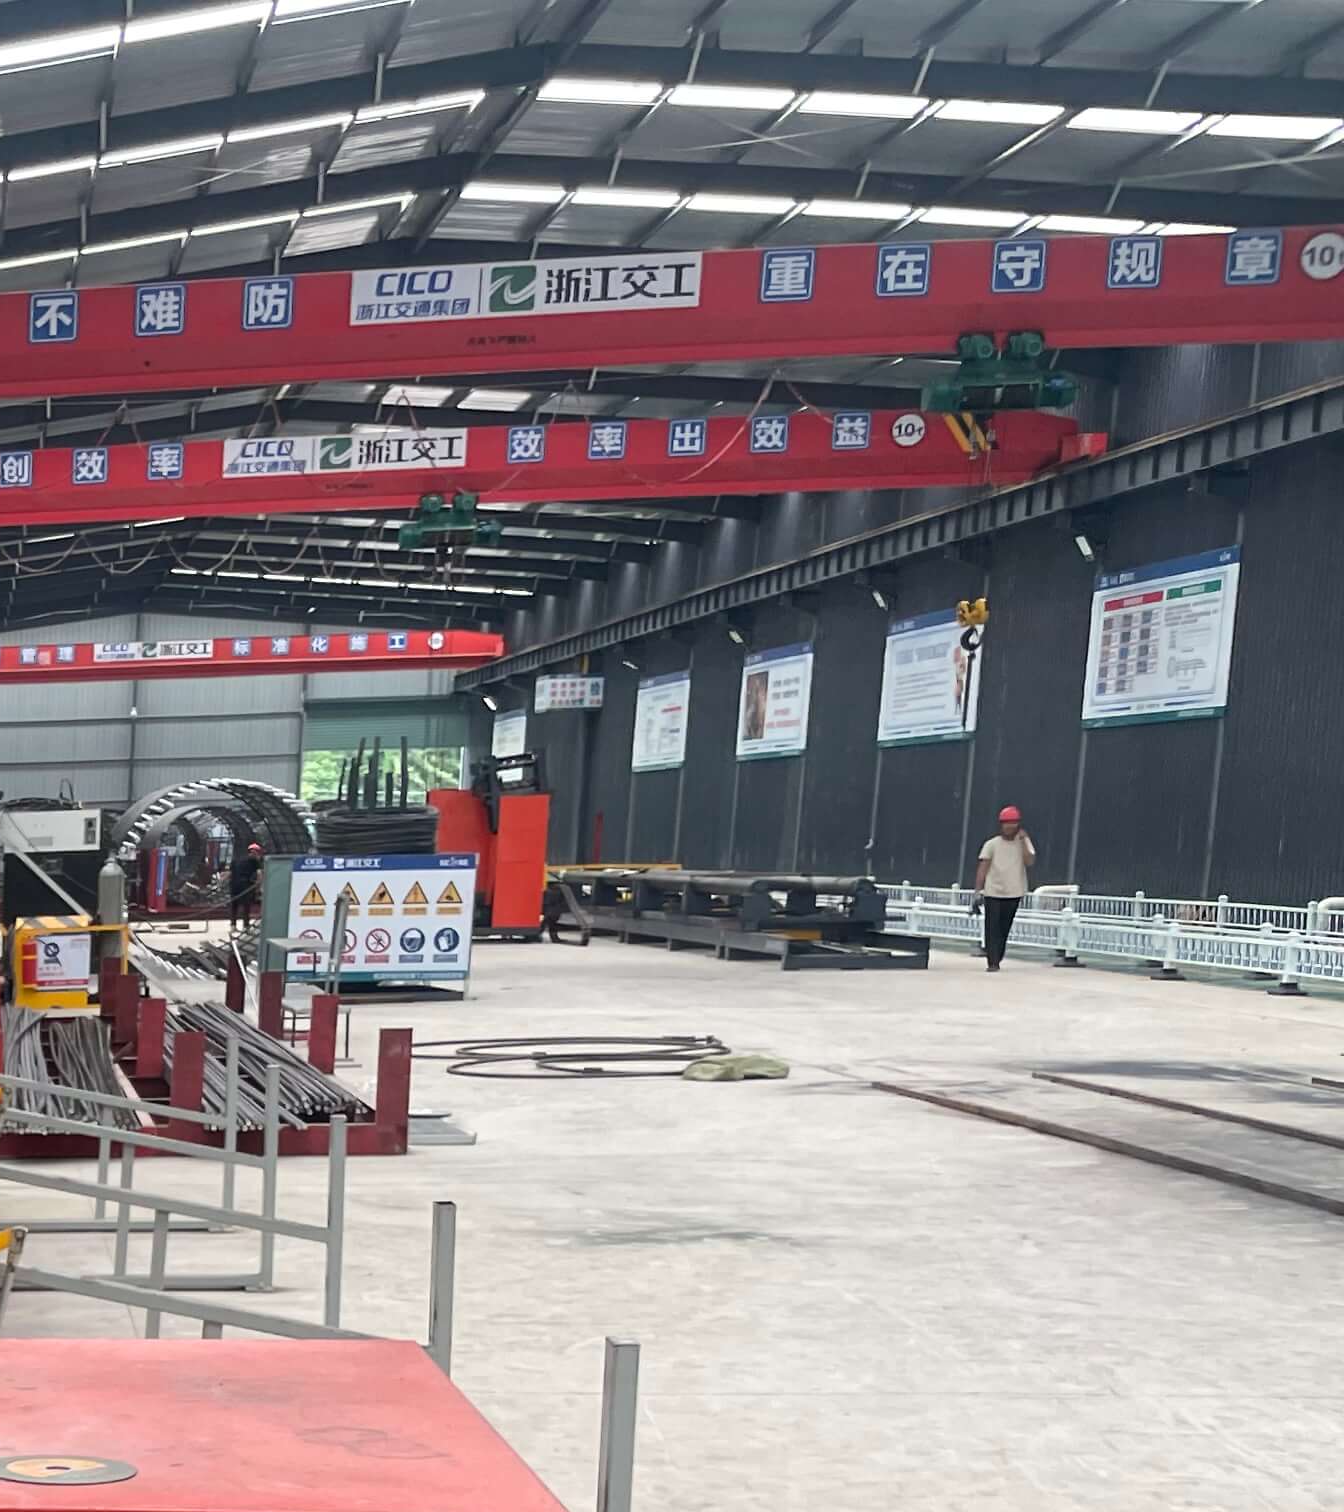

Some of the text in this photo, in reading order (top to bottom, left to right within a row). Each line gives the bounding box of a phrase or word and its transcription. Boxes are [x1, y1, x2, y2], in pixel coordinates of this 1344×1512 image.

[375, 269, 452, 297] CICO
[544, 264, 695, 305] 浙江交工
[766, 236, 1277, 298] 重在守规章
[356, 298, 470, 320] 浙江交通集团
[240, 440, 292, 458] CICO
[358, 431, 464, 466] 浙江交工
[513, 414, 868, 460] 效率出效益
